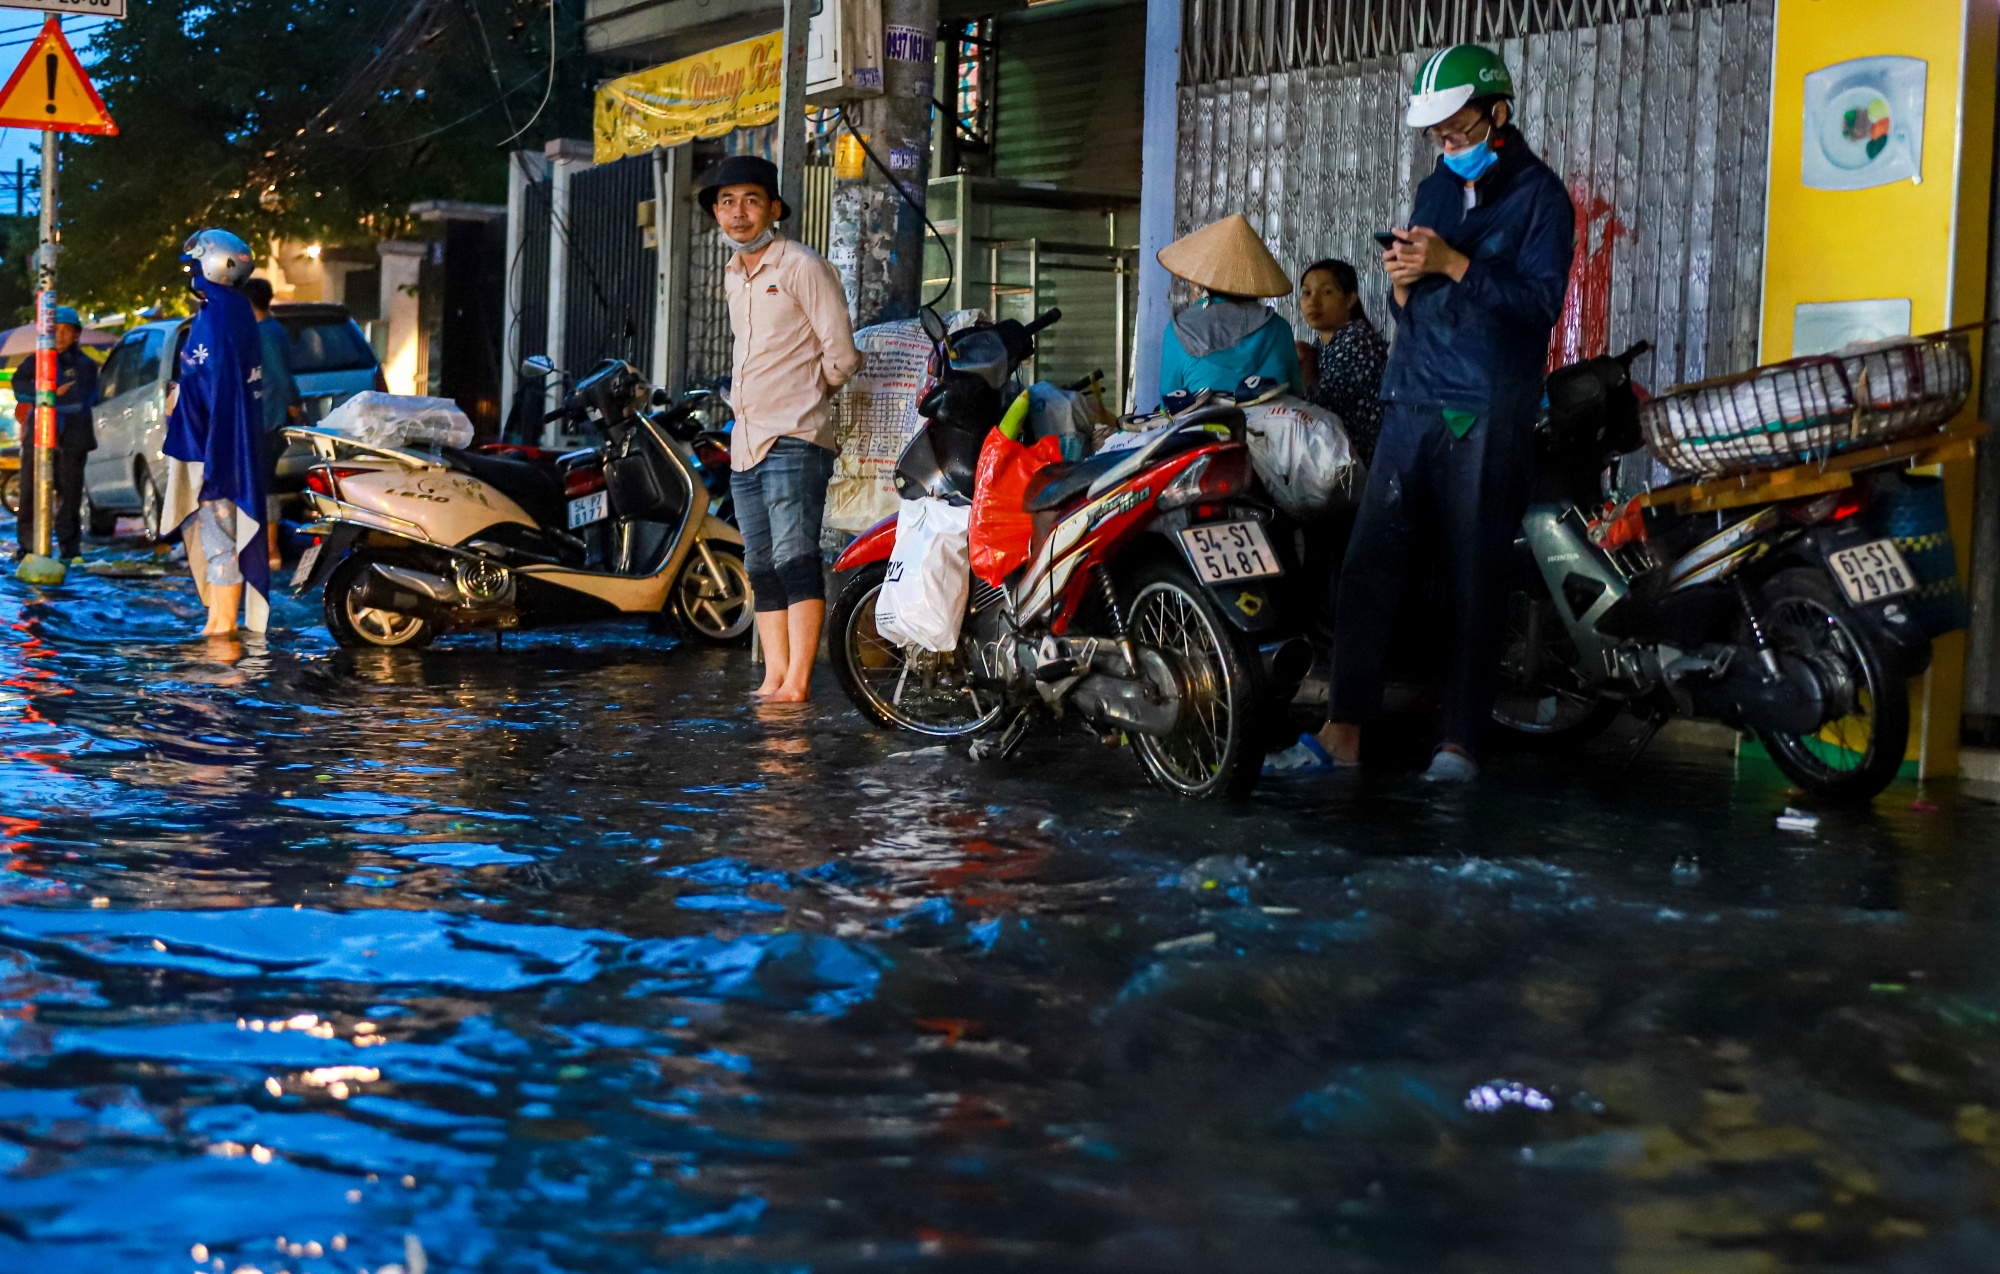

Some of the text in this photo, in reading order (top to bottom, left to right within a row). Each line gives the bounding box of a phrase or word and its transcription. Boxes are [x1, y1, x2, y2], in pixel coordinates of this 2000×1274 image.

[575, 506, 602, 525] 8177
[1192, 524, 1255, 553] 54-S1
[1204, 550, 1267, 579] 5481
[1547, 552, 1580, 563] HONDA
[1838, 543, 1892, 575] 61-S1
